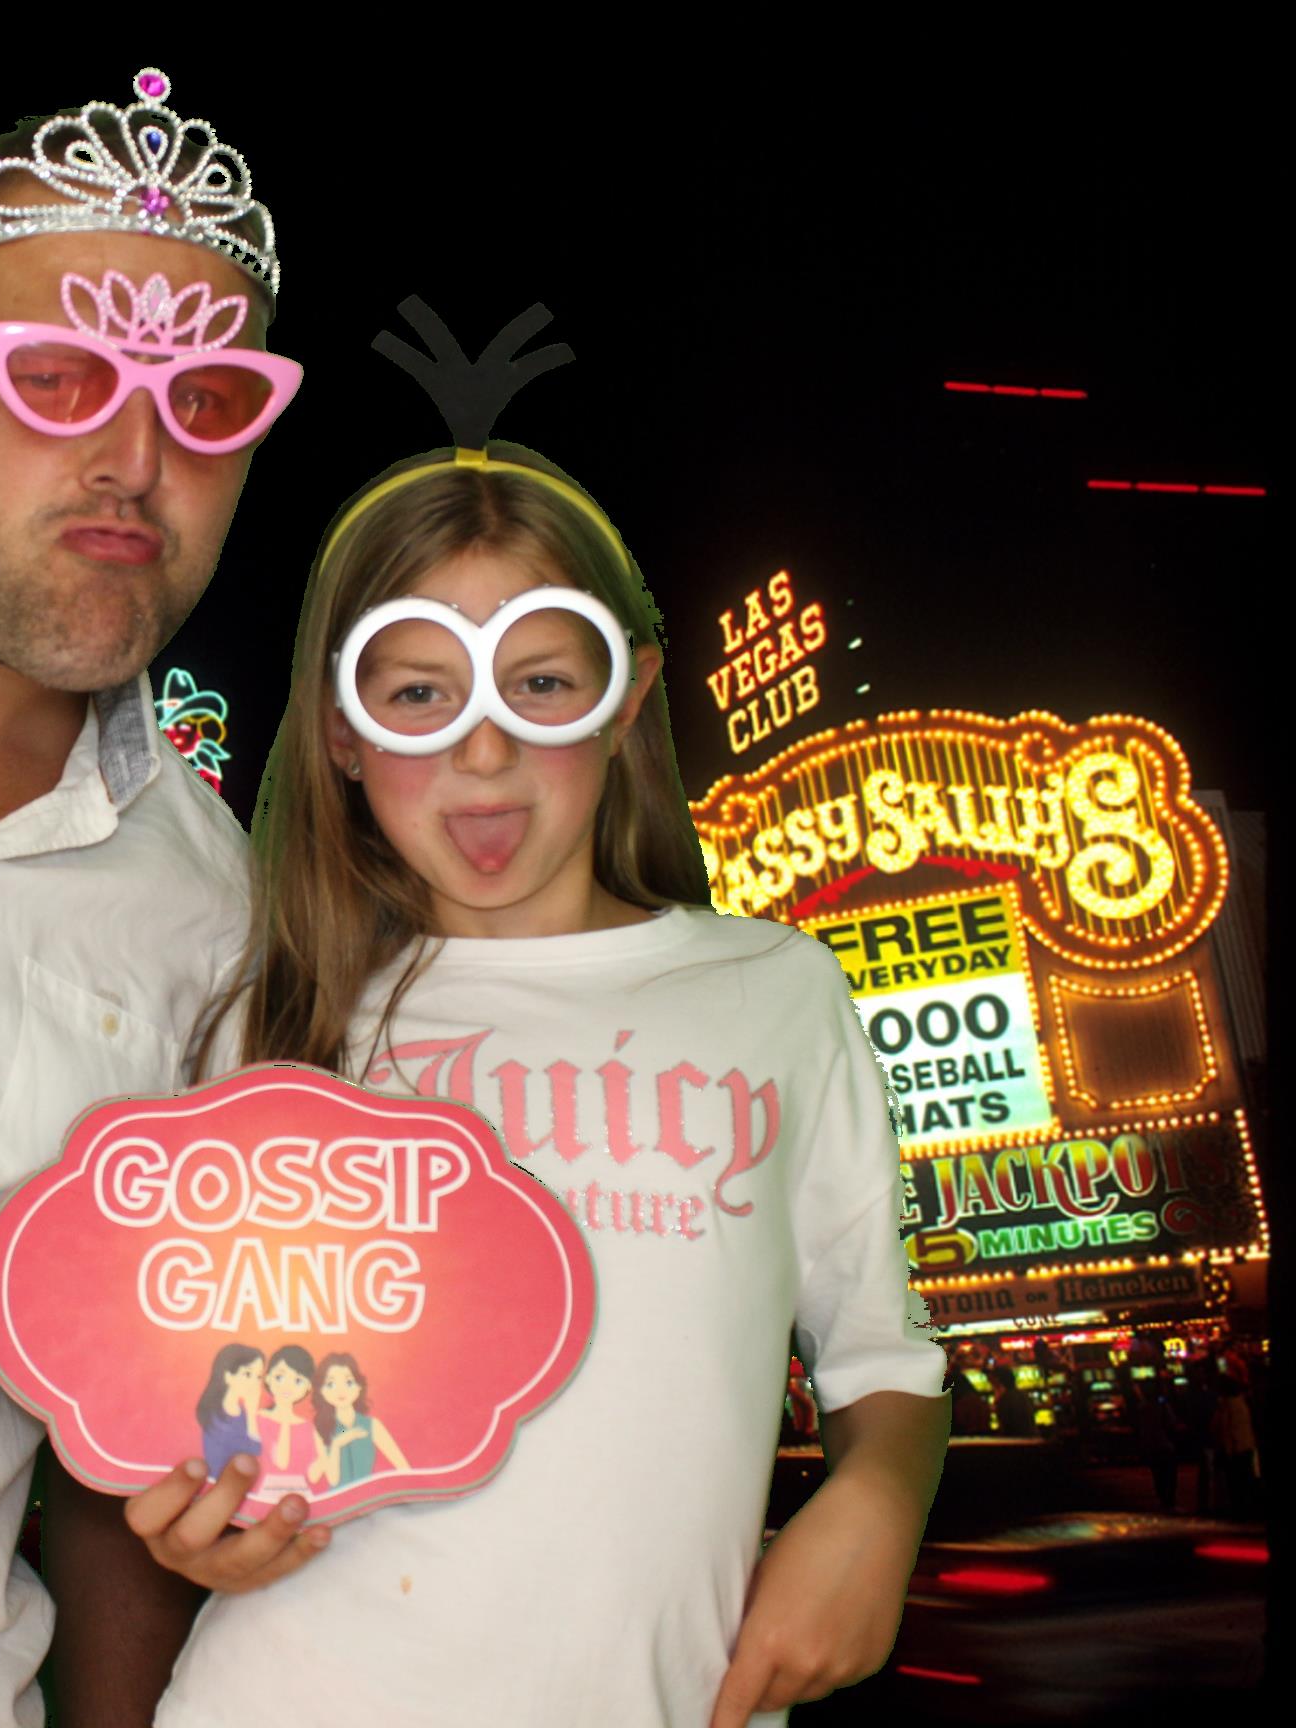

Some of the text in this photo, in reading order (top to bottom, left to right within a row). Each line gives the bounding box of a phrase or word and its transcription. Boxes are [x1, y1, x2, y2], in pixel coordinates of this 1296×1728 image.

[718, 569, 794, 654] LAS
[707, 602, 826, 711] VEGAS
[726, 664, 820, 754] CLUB
[815, 896, 1009, 963] FREE
[93, 1137, 470, 1233] GOSSIP
[136, 1237, 425, 1334] GANG
[913, 1211, 1160, 1273] 5 MINUTES
[1061, 1270, 1192, 1302] Heineken
